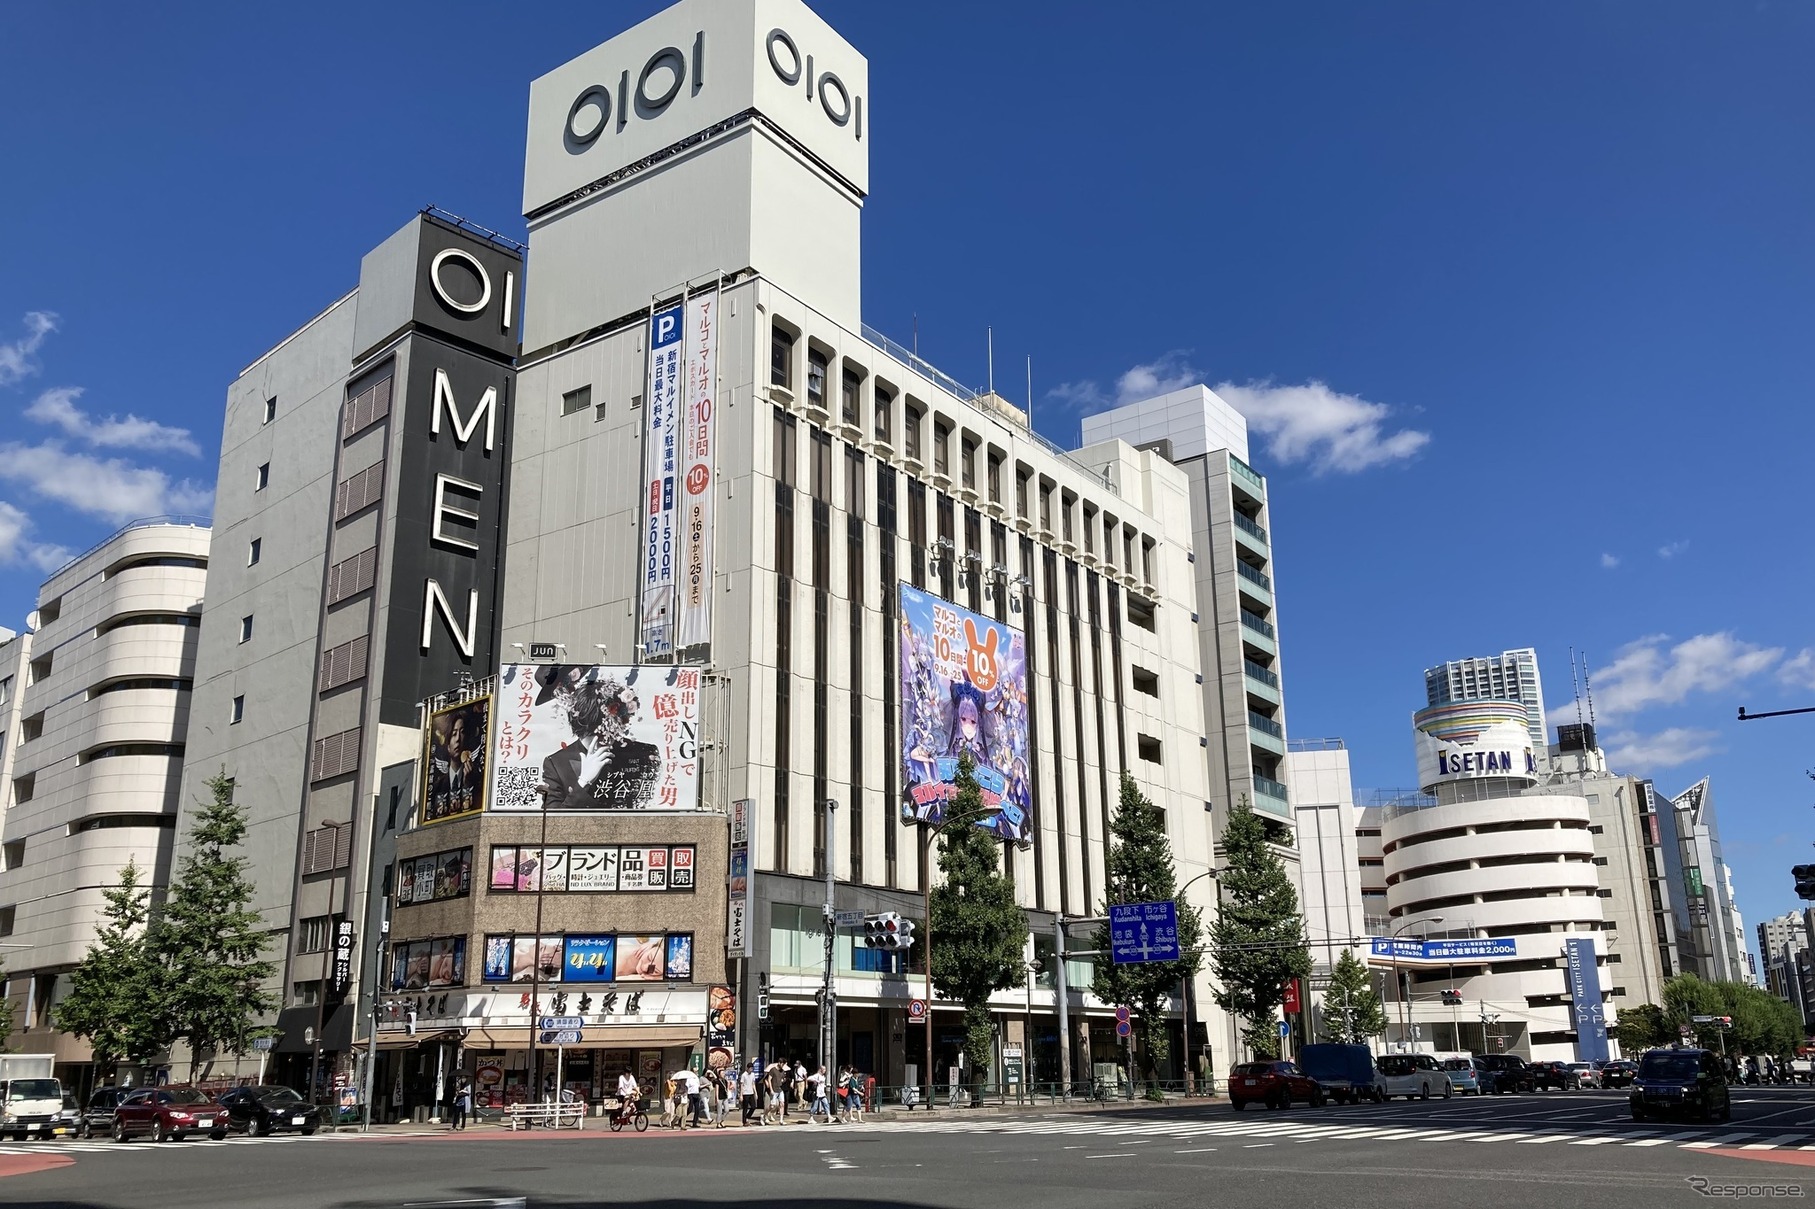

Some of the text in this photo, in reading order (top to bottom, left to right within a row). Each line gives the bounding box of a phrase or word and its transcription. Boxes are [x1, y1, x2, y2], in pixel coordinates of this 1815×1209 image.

[658, 315, 675, 344] P
[652, 354, 664, 430] 当日最大料金
[422, 367, 497, 657] MEN
[648, 516, 658, 585] 2000円
[661, 514, 671, 580] 1500円
[977, 676, 989, 687] OFF
[515, 667, 534, 761] そのカラクリ
[1438, 749, 1512, 775] ISETAN
[594, 779, 631, 799] 渋谷
[546, 851, 643, 872] ブランド品
[650, 850, 691, 867] 買取
[649, 870, 690, 885] 販売
[1115, 905, 1140, 917] 九段下
[337, 921, 352, 961] 銀の蔵
[1114, 929, 1133, 939] 池袋
[1155, 926, 1175, 936] 渋谷
[1377, 942, 1388, 952] P
